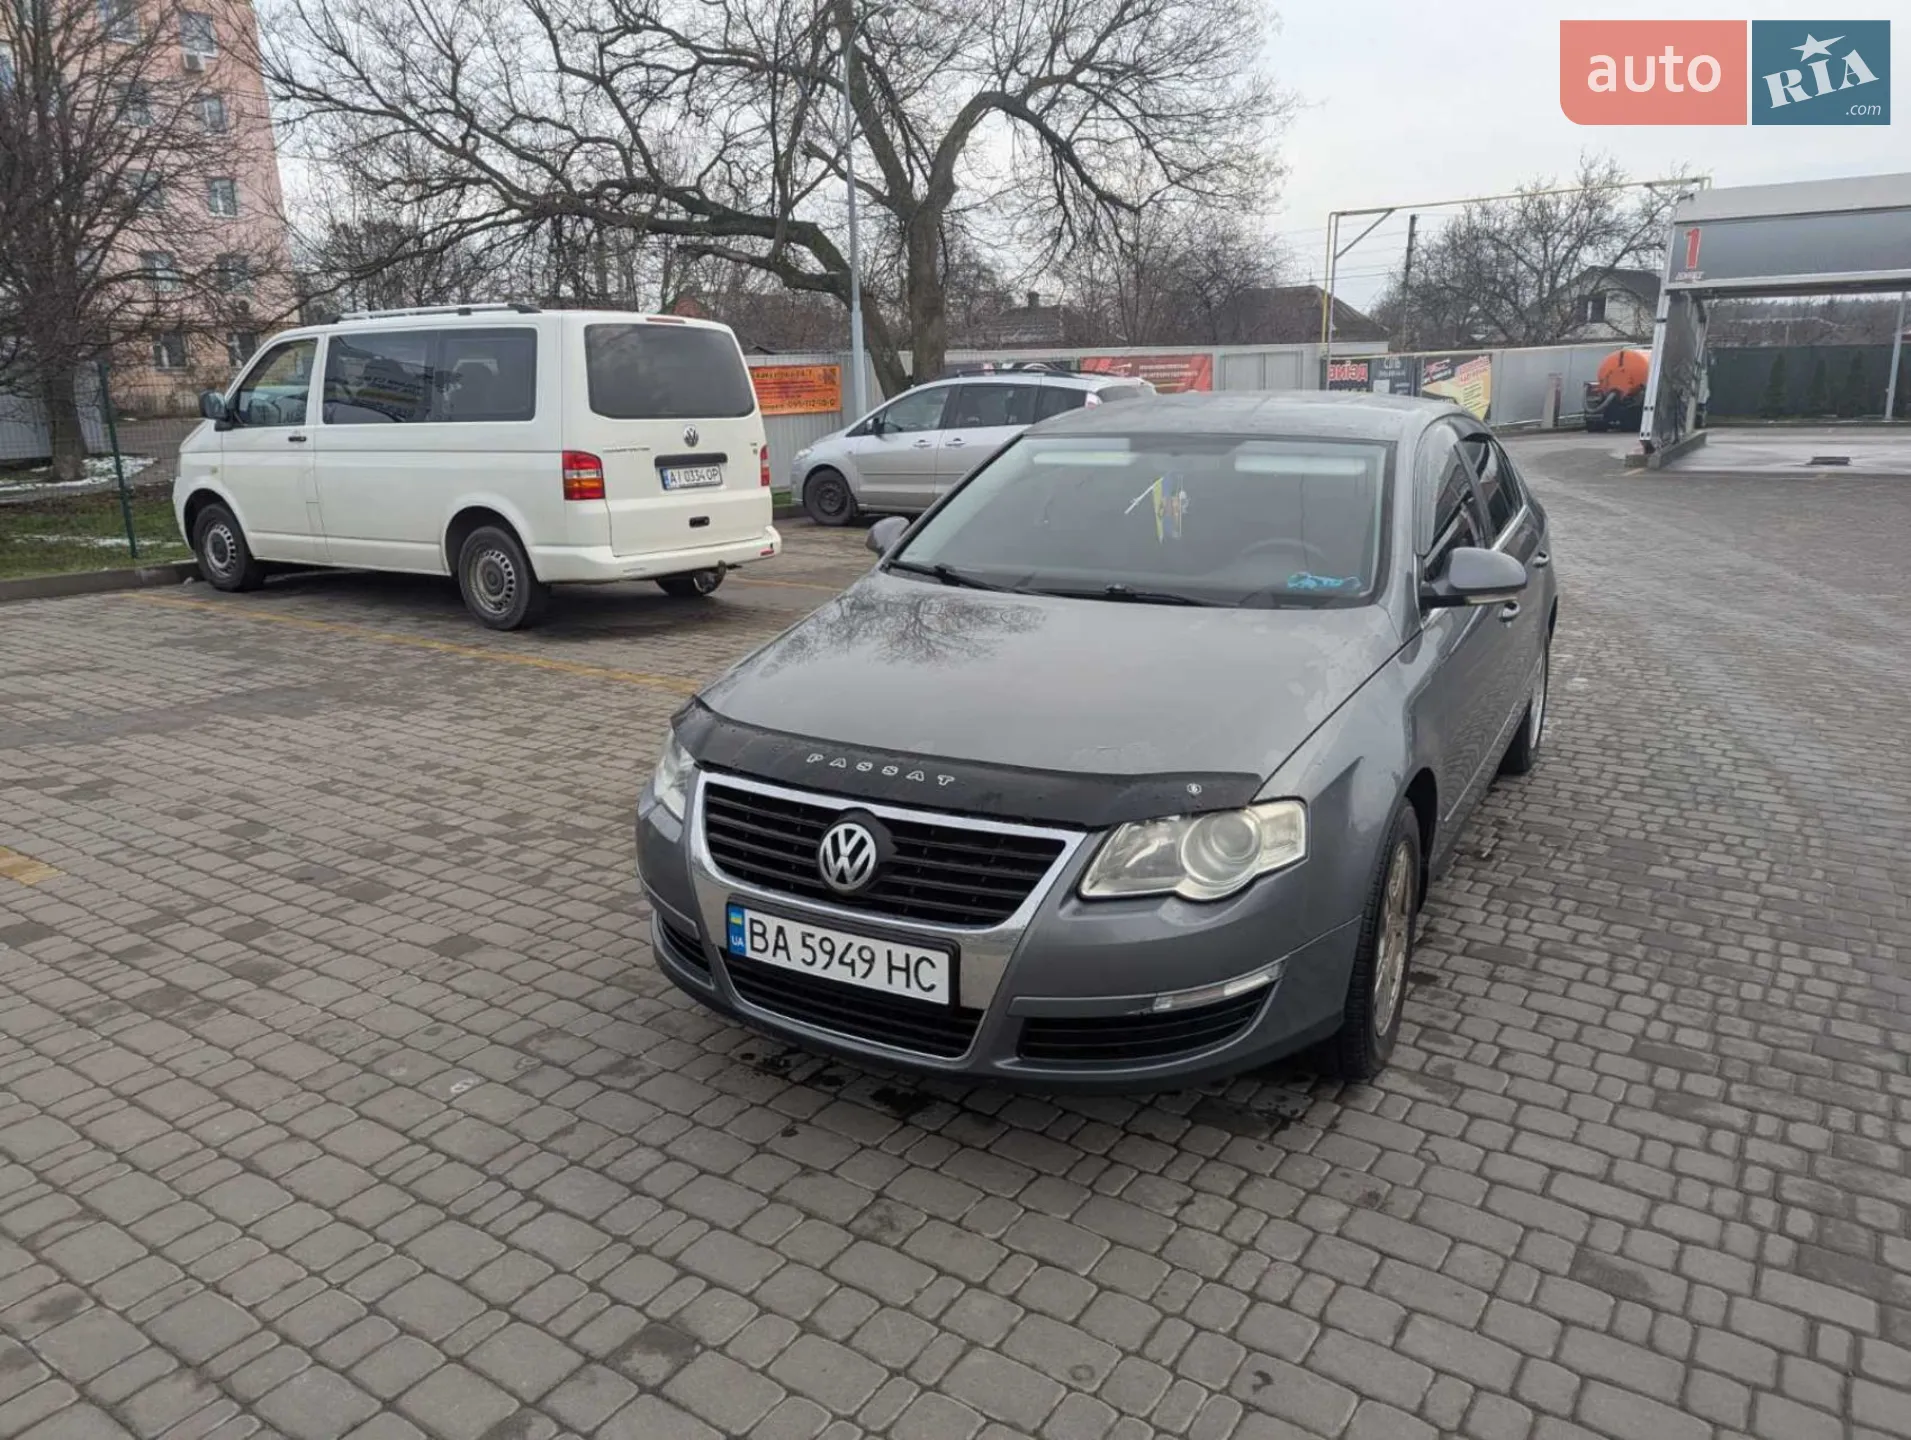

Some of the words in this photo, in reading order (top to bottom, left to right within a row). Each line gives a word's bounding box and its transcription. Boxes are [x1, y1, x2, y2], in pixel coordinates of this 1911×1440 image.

[1683, 227, 1702, 269] 1
[806, 753, 956, 786] PASSAT
[731, 935, 745, 948] UA
[749, 917, 792, 962] BA
[801, 931, 876, 980] 5949
[886, 949, 937, 993] HC
